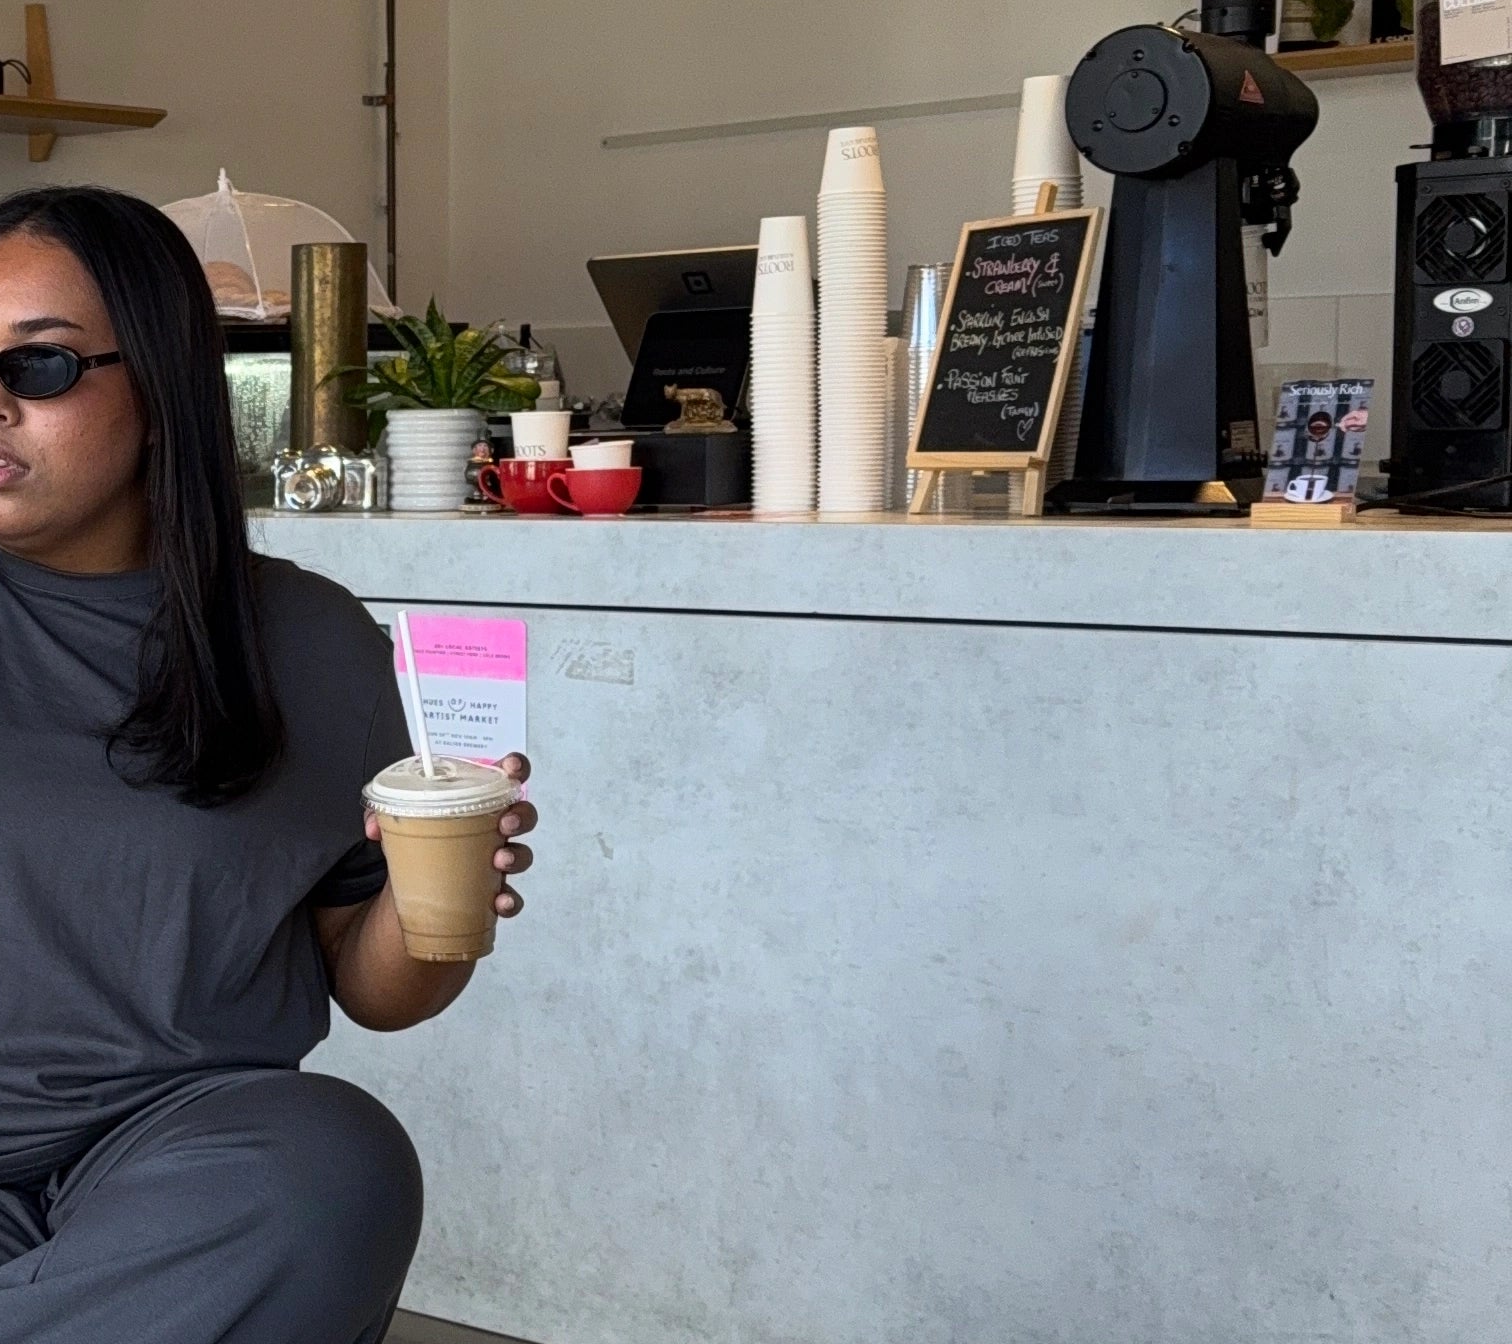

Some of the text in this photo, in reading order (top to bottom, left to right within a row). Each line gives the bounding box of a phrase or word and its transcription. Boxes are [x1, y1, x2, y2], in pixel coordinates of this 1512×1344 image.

[1023, 229, 1059, 245] TEAS
[984, 277, 1027, 294] CREAM
[1289, 382, 1363, 399] Seriously Rich
[469, 701, 497, 710] HAPPY
[459, 714, 499, 725] MARKET
